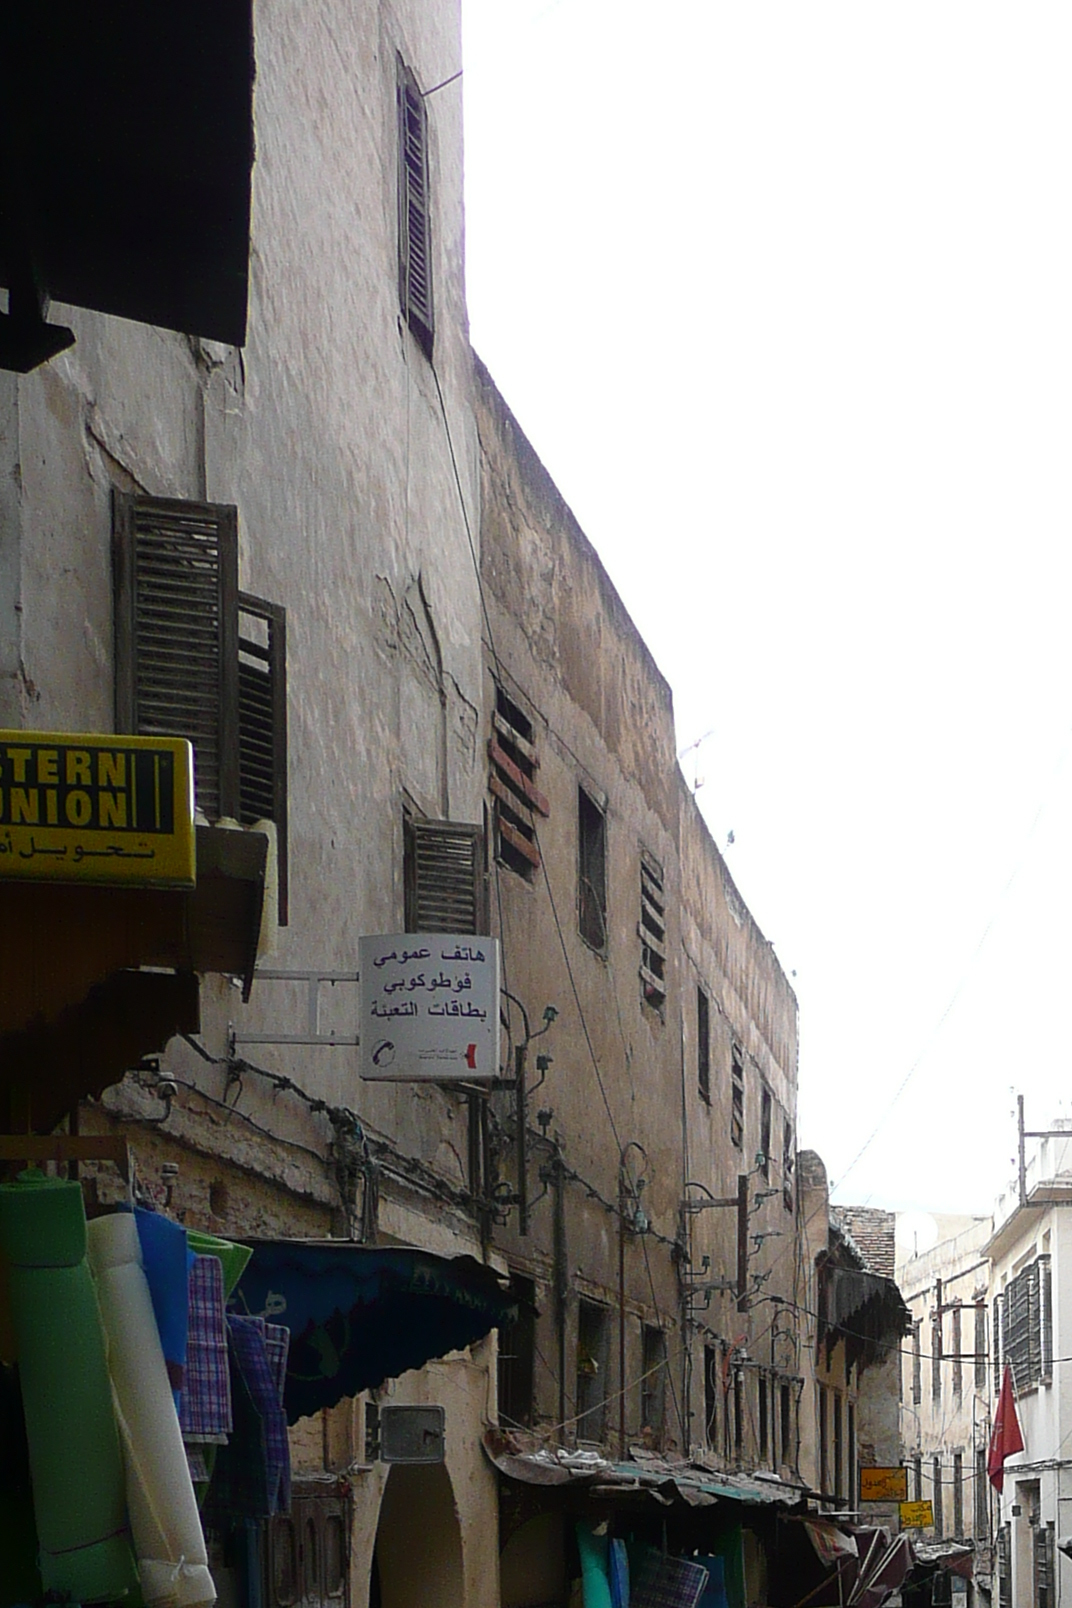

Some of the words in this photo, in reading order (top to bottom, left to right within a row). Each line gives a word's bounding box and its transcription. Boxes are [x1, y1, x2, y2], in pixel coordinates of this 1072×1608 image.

[0, 747, 126, 787] TERN
[0, 787, 127, 827] NION
[19, 836, 155, 862] تحويل
[373, 948, 431, 969] عمومي
[441, 945, 486, 962] هاتف
[383, 971, 472, 995] فوطوكوبي
[370, 1000, 418, 1021] التعبئة
[428, 1000, 487, 1022] بطاقات
